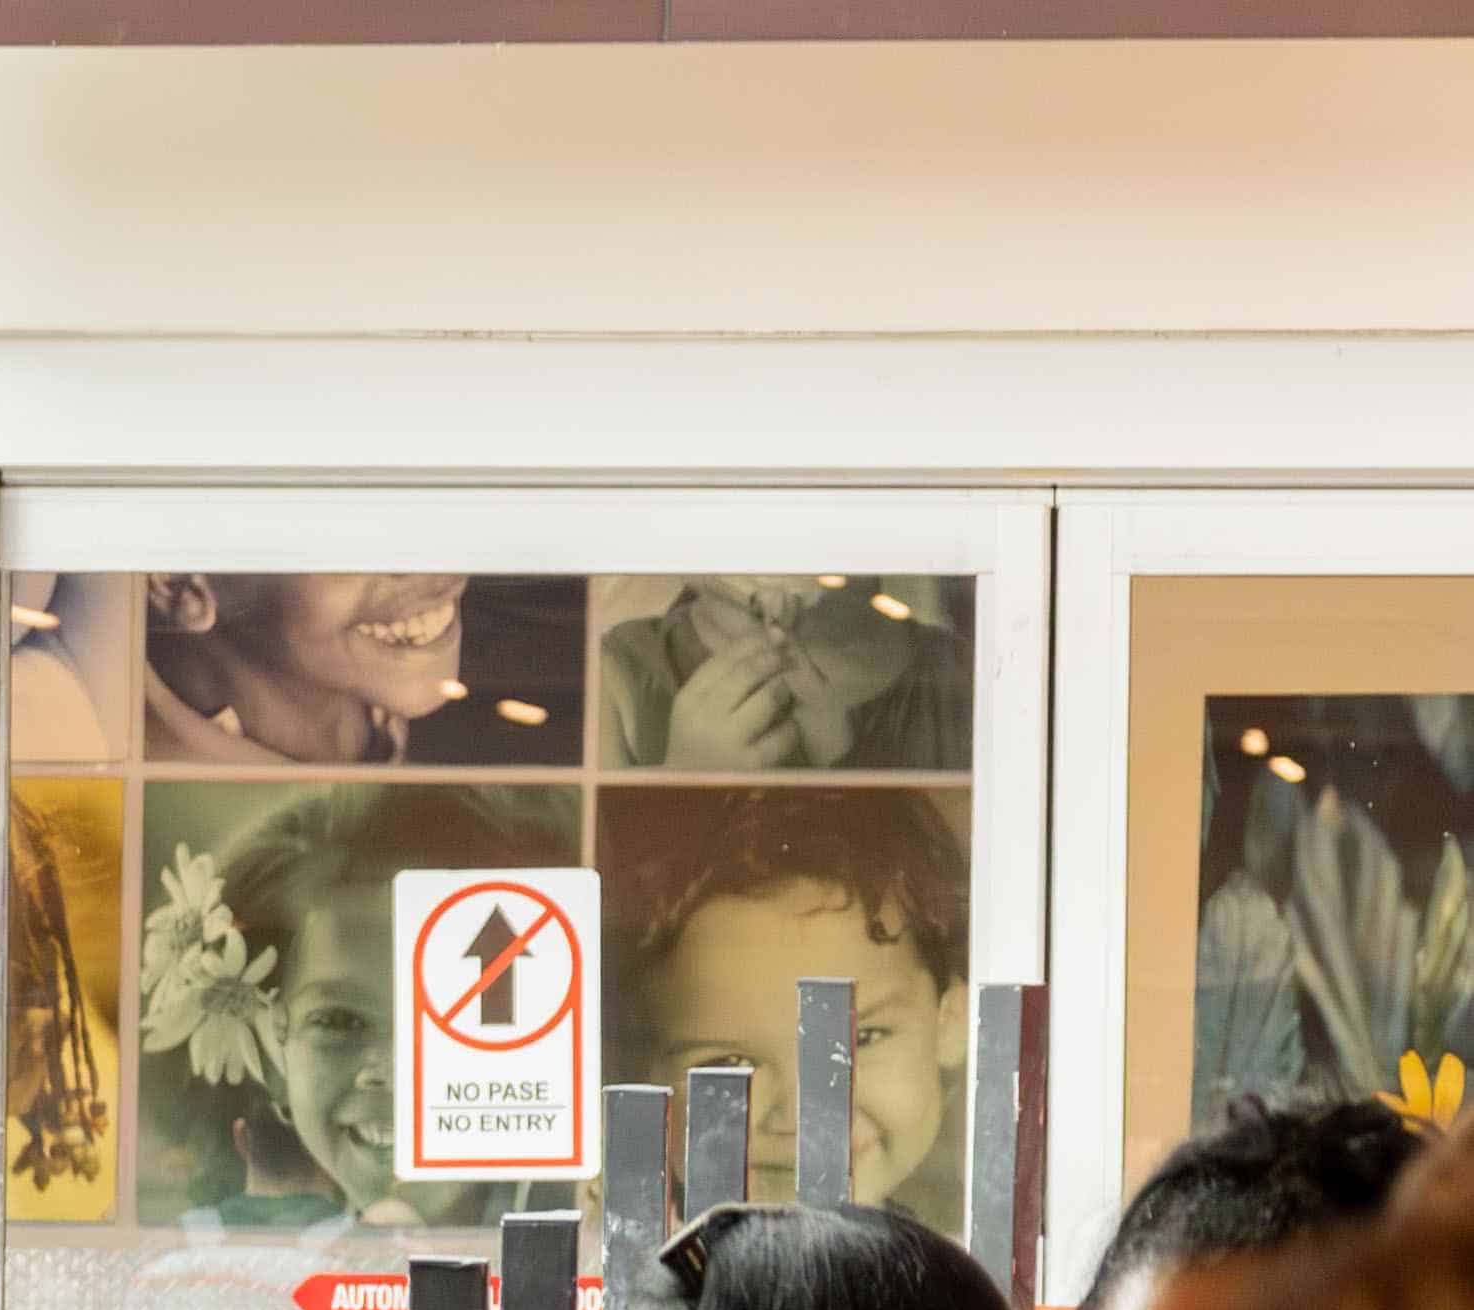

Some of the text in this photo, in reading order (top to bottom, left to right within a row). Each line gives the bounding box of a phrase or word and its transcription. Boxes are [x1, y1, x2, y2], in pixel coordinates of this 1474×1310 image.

[446, 1081, 550, 1102] NO PASE
[437, 1113, 557, 1132] NO ENTRY
